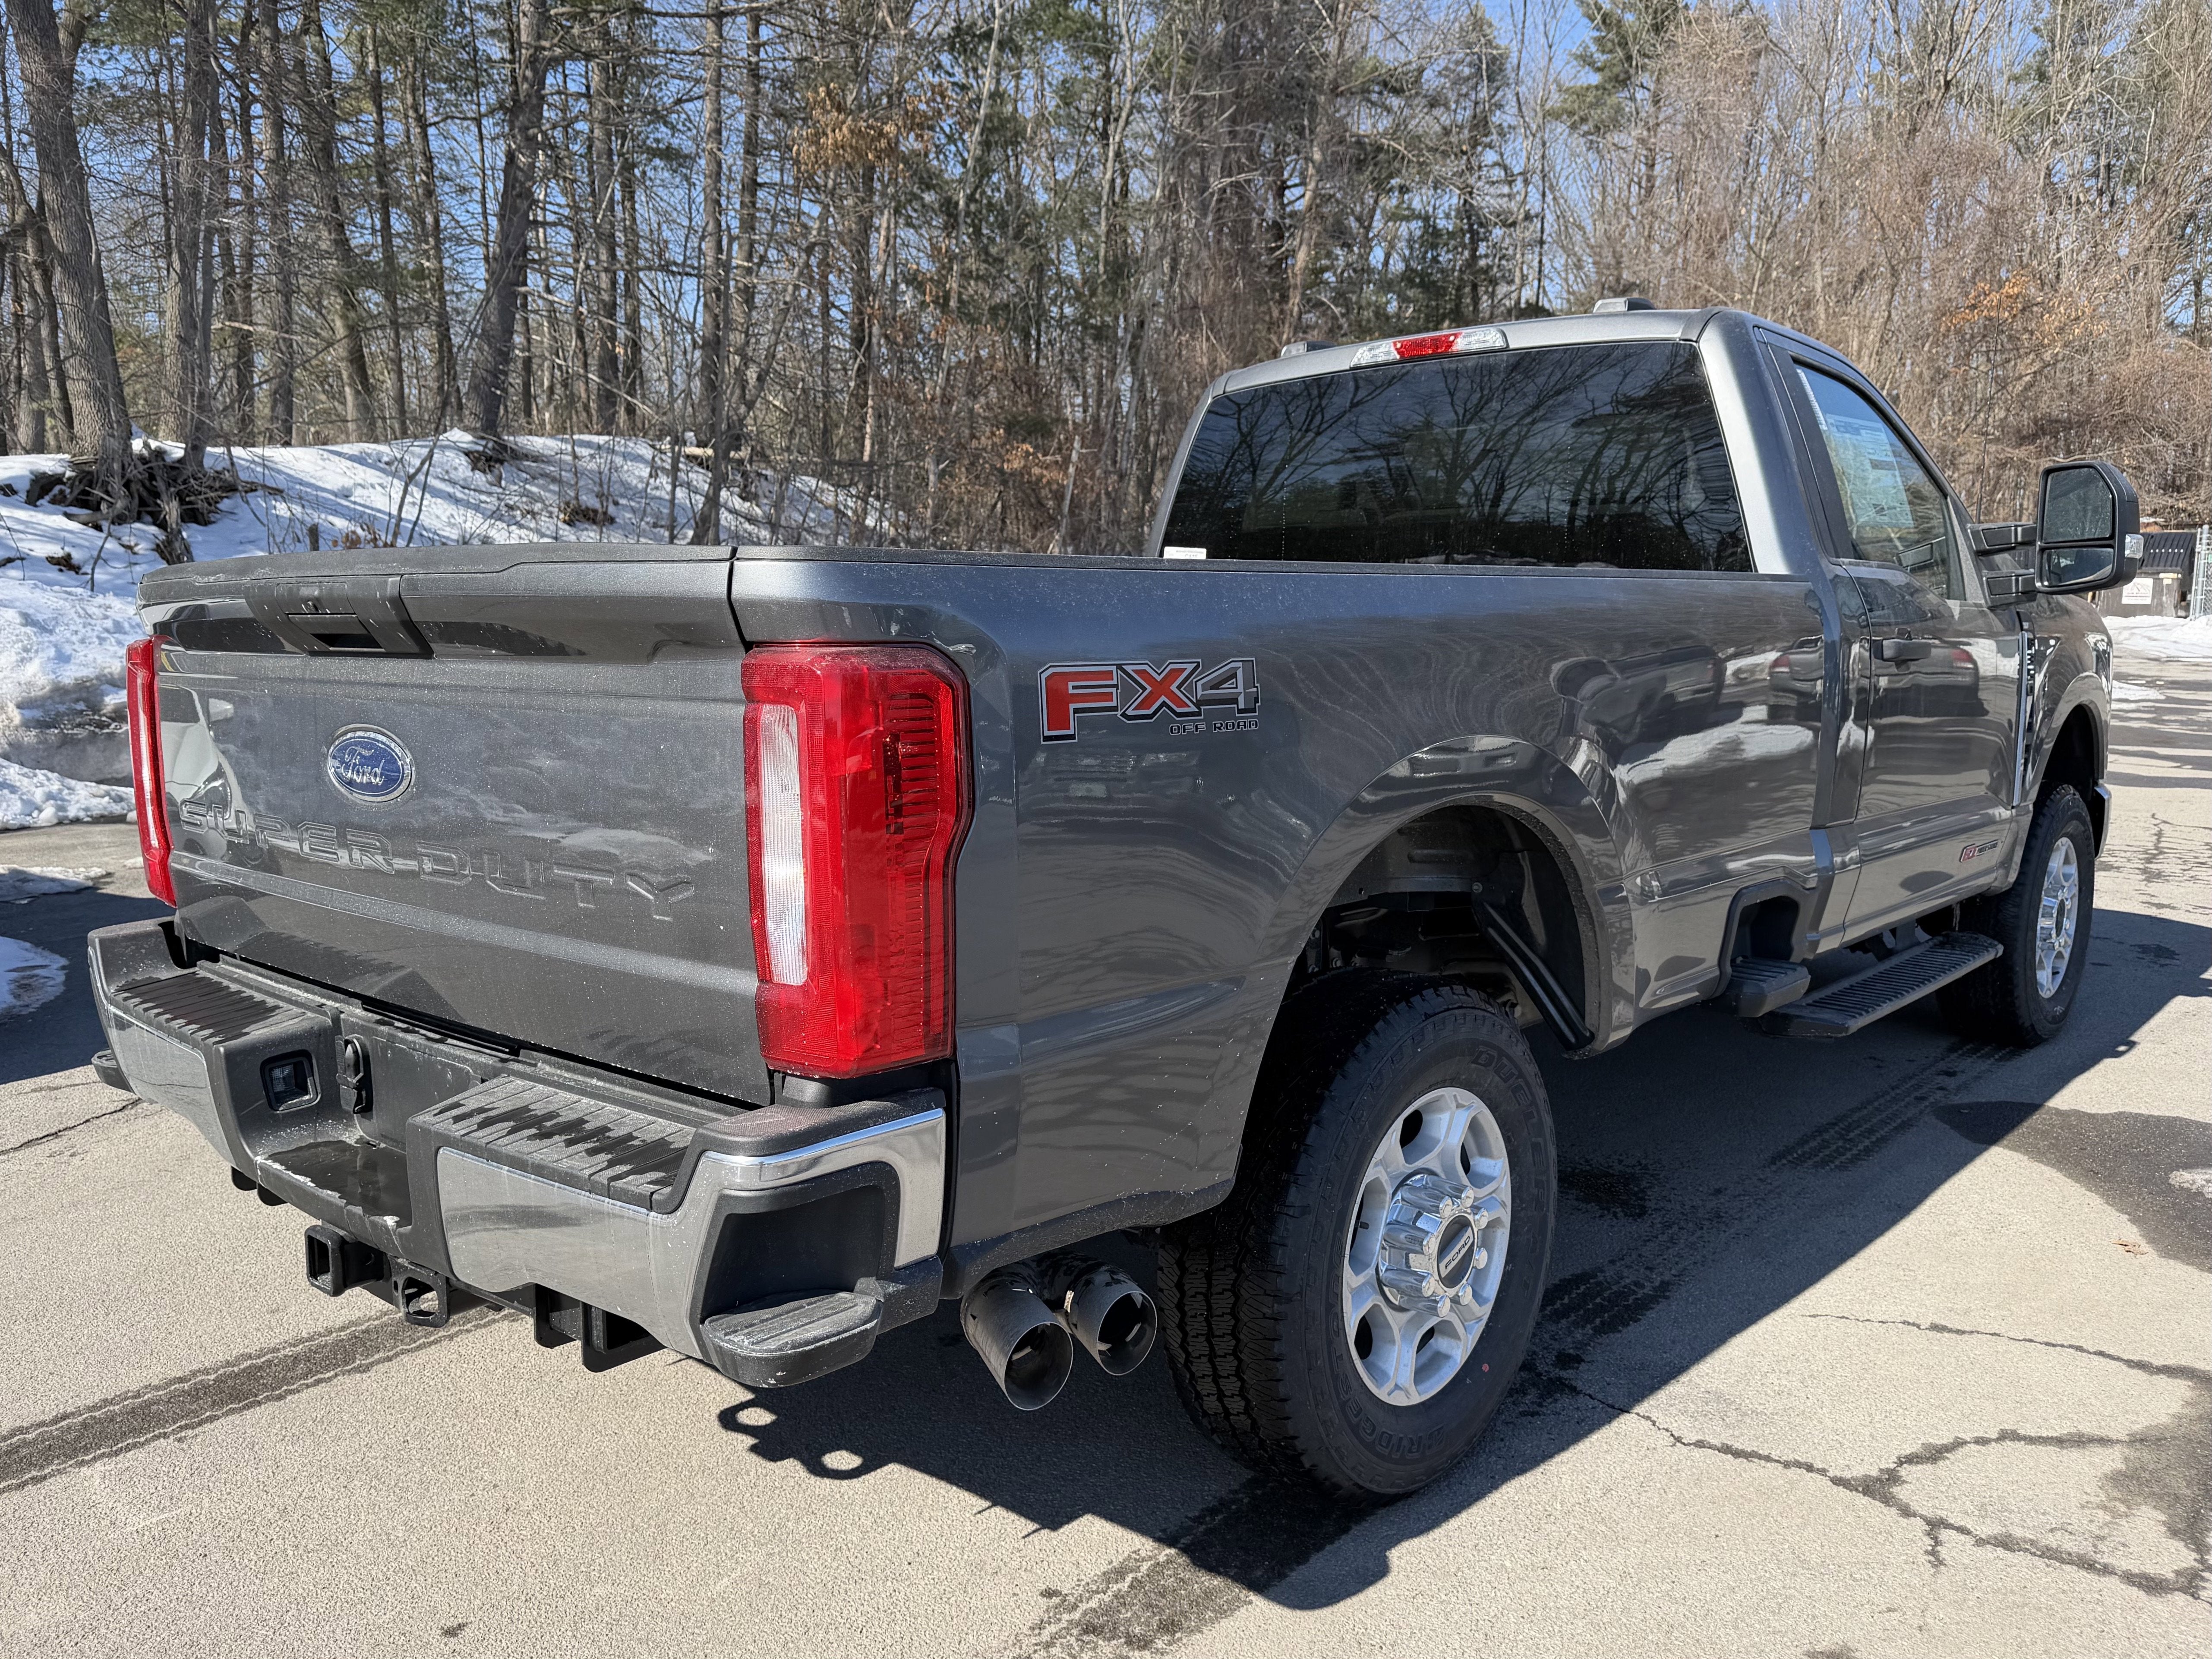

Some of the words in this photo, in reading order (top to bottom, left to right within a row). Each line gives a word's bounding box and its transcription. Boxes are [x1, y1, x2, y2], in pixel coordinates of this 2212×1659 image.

[1038, 657, 1261, 744] FX4
[1169, 722, 1206, 735] OFF
[1212, 719, 1259, 733] ROAD
[341, 745, 385, 786] Ford
[179, 798, 395, 874] SUPER
[416, 839, 695, 921] DUTY
[1445, 1235, 1470, 1269] FORD
